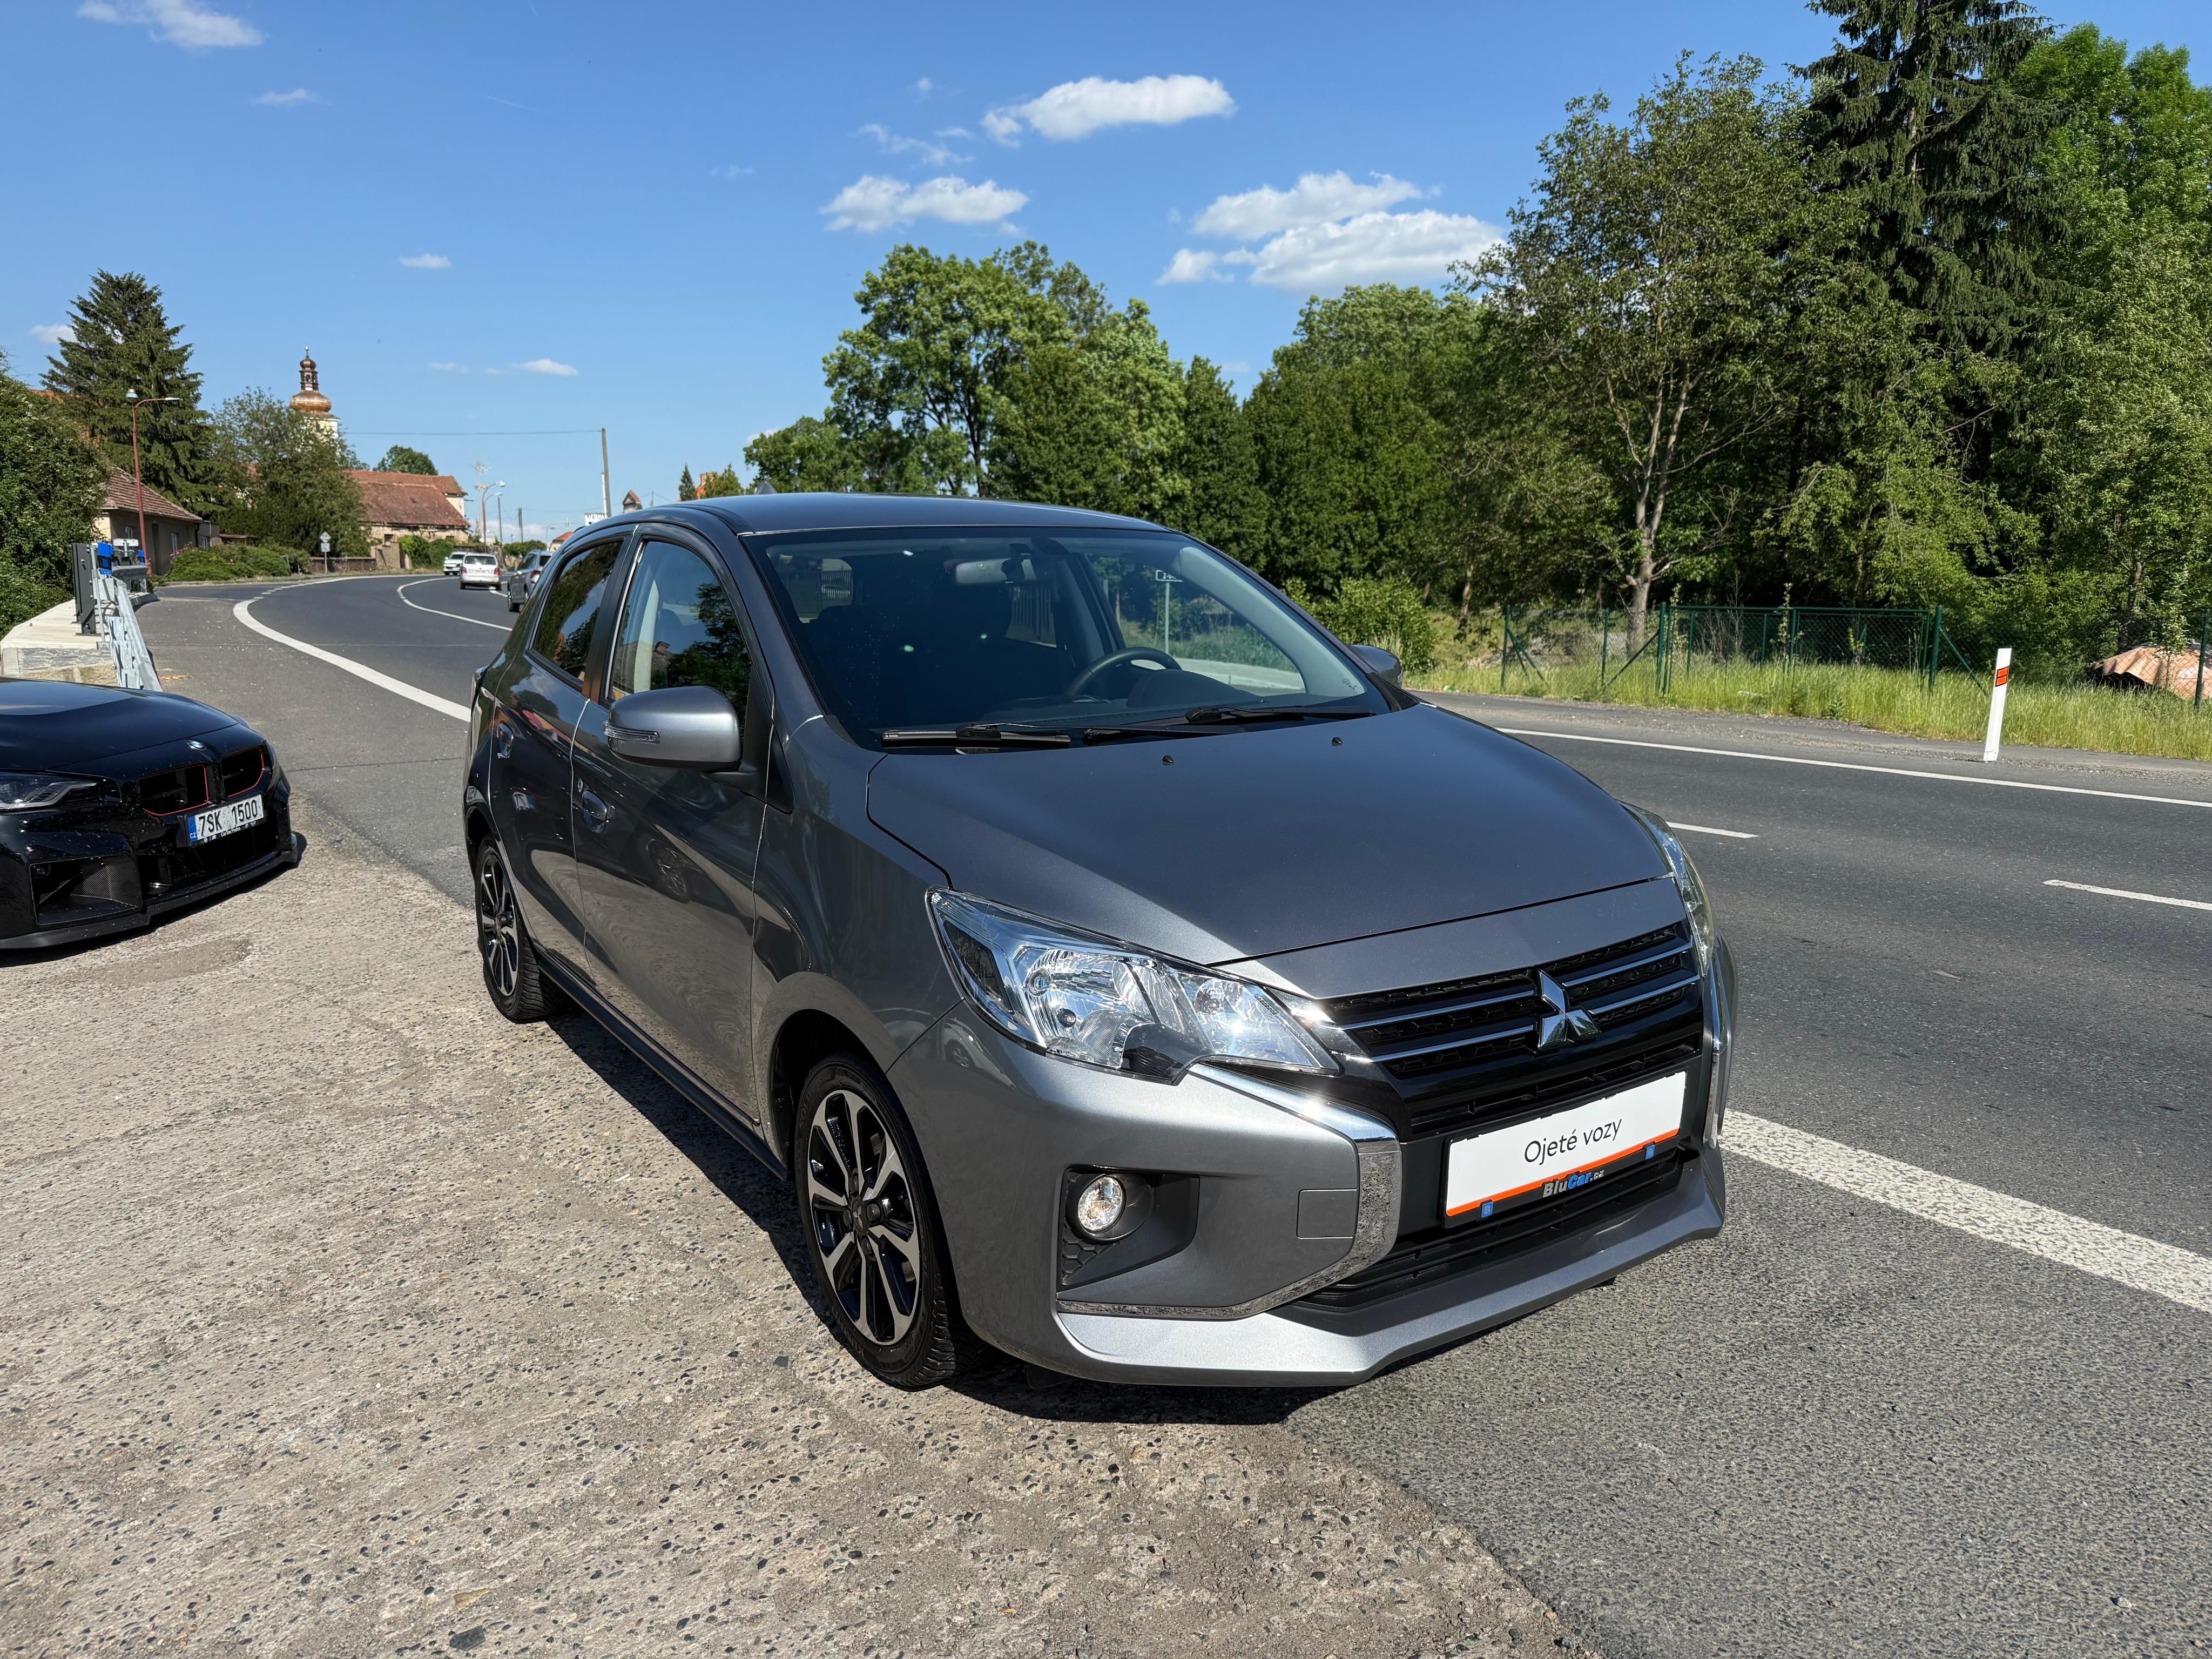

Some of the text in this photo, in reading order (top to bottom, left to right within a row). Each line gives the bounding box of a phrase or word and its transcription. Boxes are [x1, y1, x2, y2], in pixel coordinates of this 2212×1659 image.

[198, 800, 258, 837] 7SK 1500
[1525, 1118, 1622, 1165] Ojeté vozy
[1543, 1170, 1604, 1198] BluCar.cz
